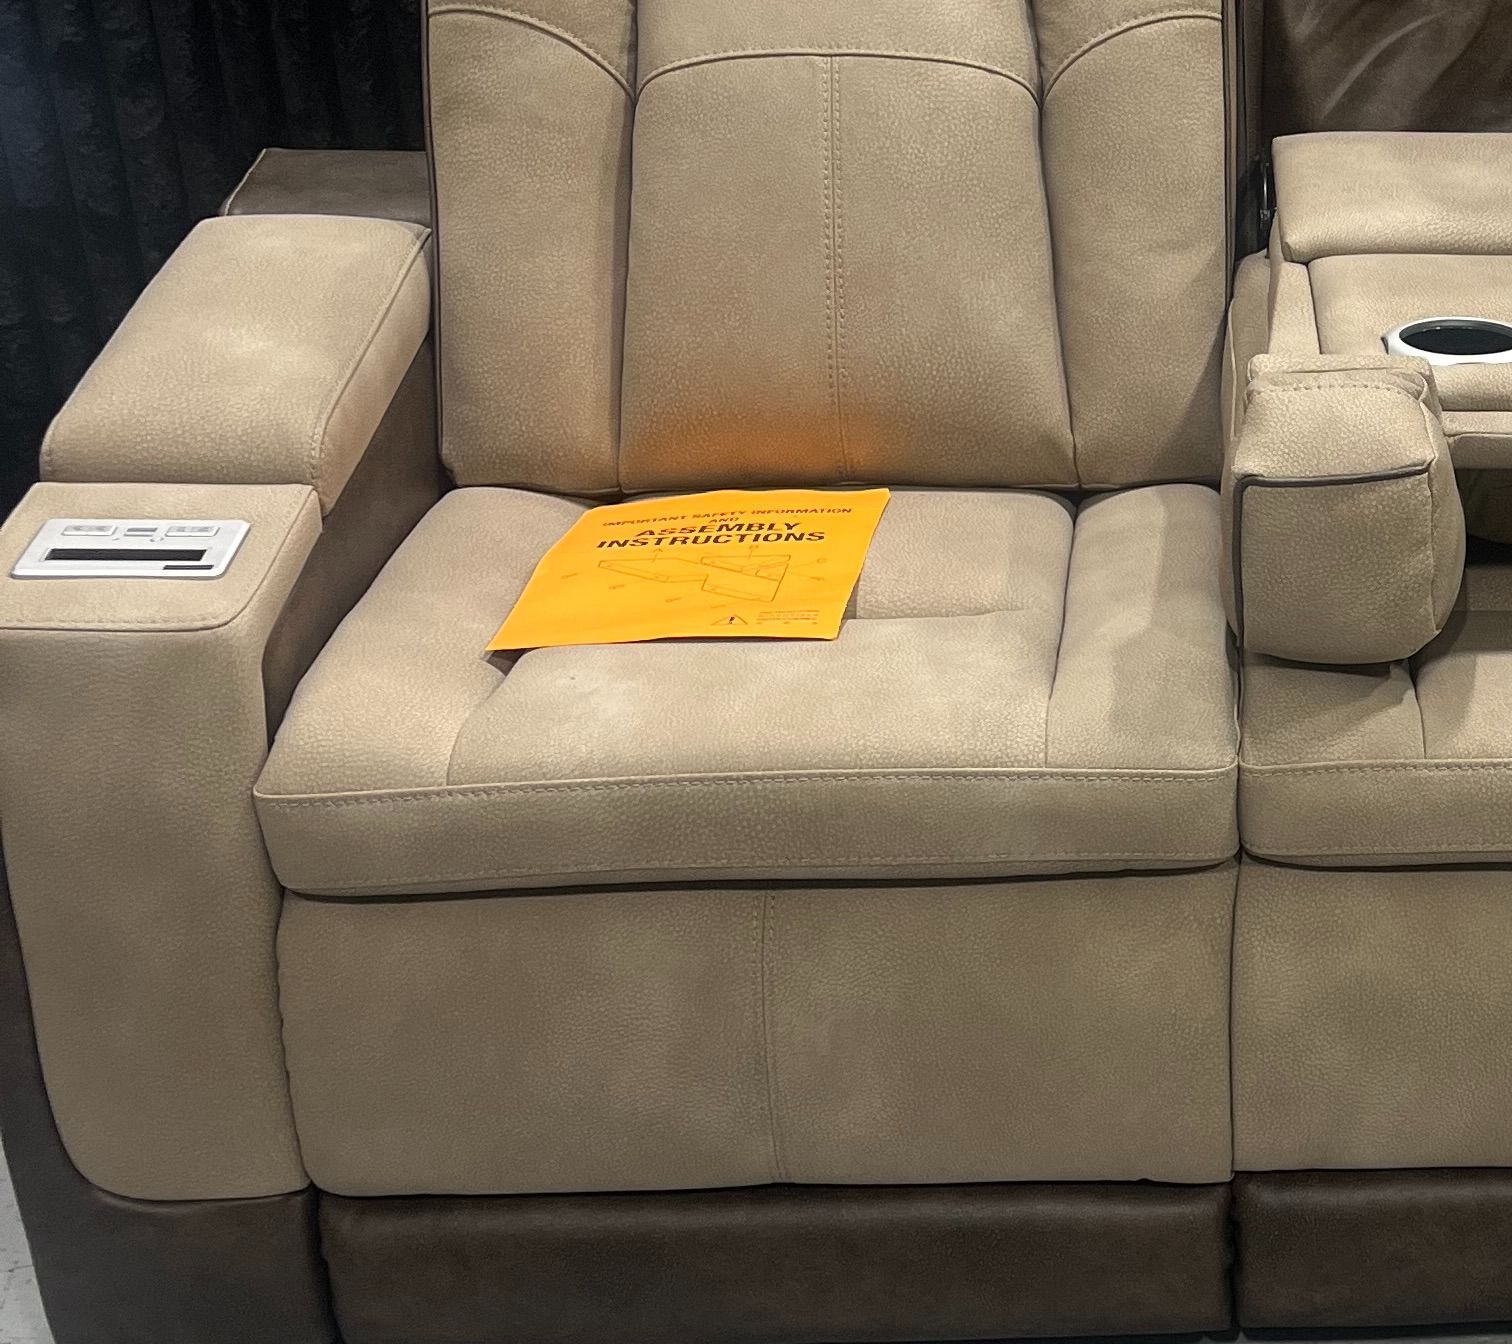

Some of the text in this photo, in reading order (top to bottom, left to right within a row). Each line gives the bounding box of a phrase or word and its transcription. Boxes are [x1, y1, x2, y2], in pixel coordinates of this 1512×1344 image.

[603, 507, 853, 526] IMPORTANT SAFETY INFORMATION
[708, 516, 740, 524] AND
[637, 522, 801, 536] ASSEMBLY
[597, 532, 825, 548] INSTRUCTIONS
